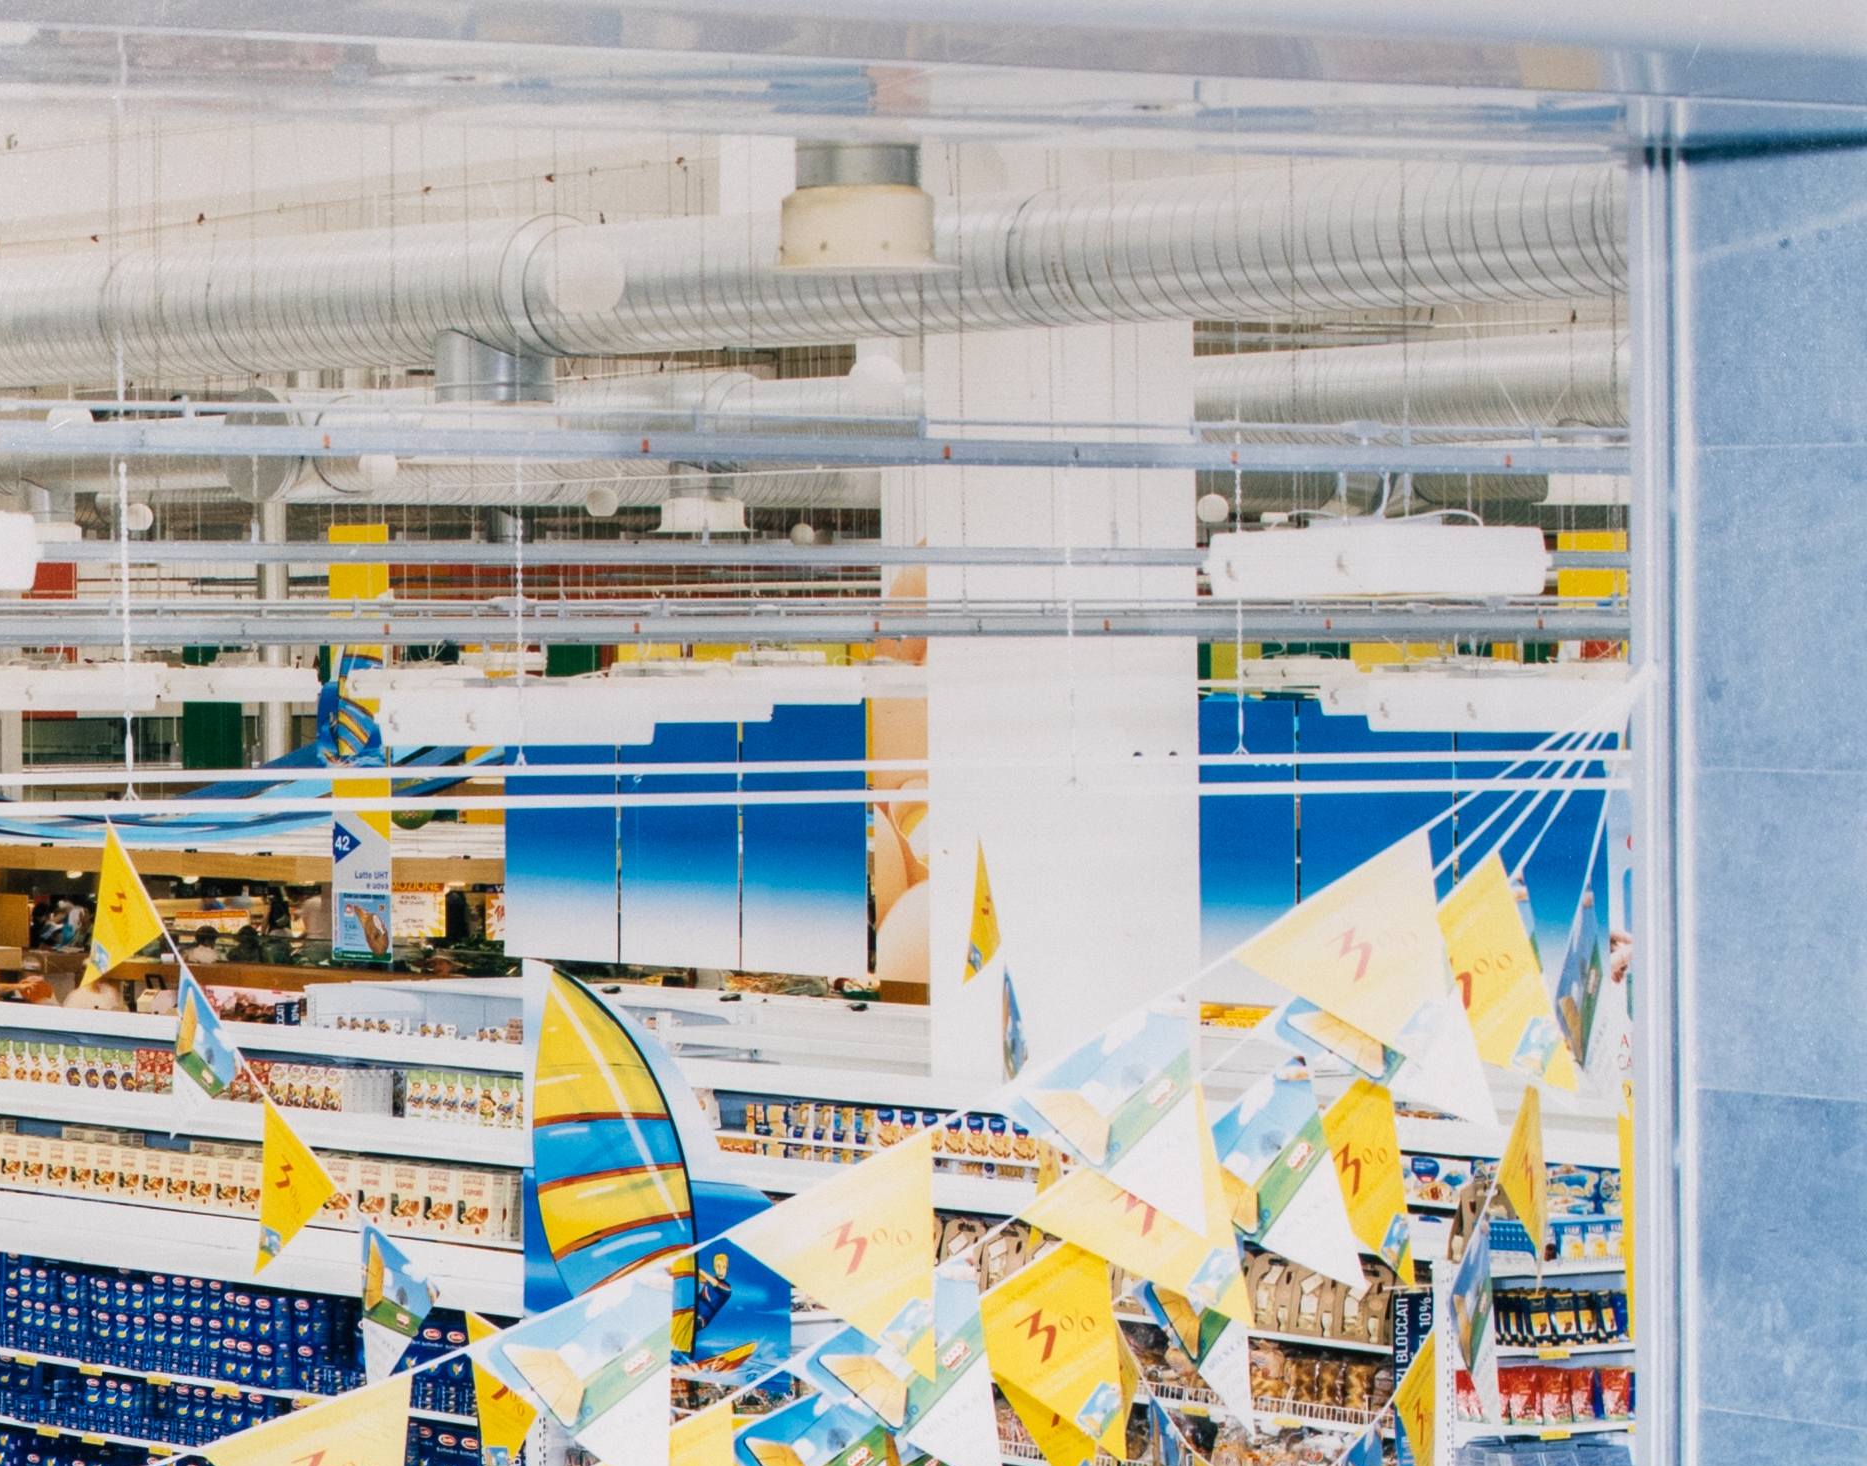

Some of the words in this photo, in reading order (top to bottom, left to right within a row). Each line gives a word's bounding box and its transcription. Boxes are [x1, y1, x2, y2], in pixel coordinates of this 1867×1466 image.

[334, 836, 350, 851] 42
[1419, 1296, 1431, 1329] 10%
[1396, 1297, 1409, 1363] BLOCCATI
